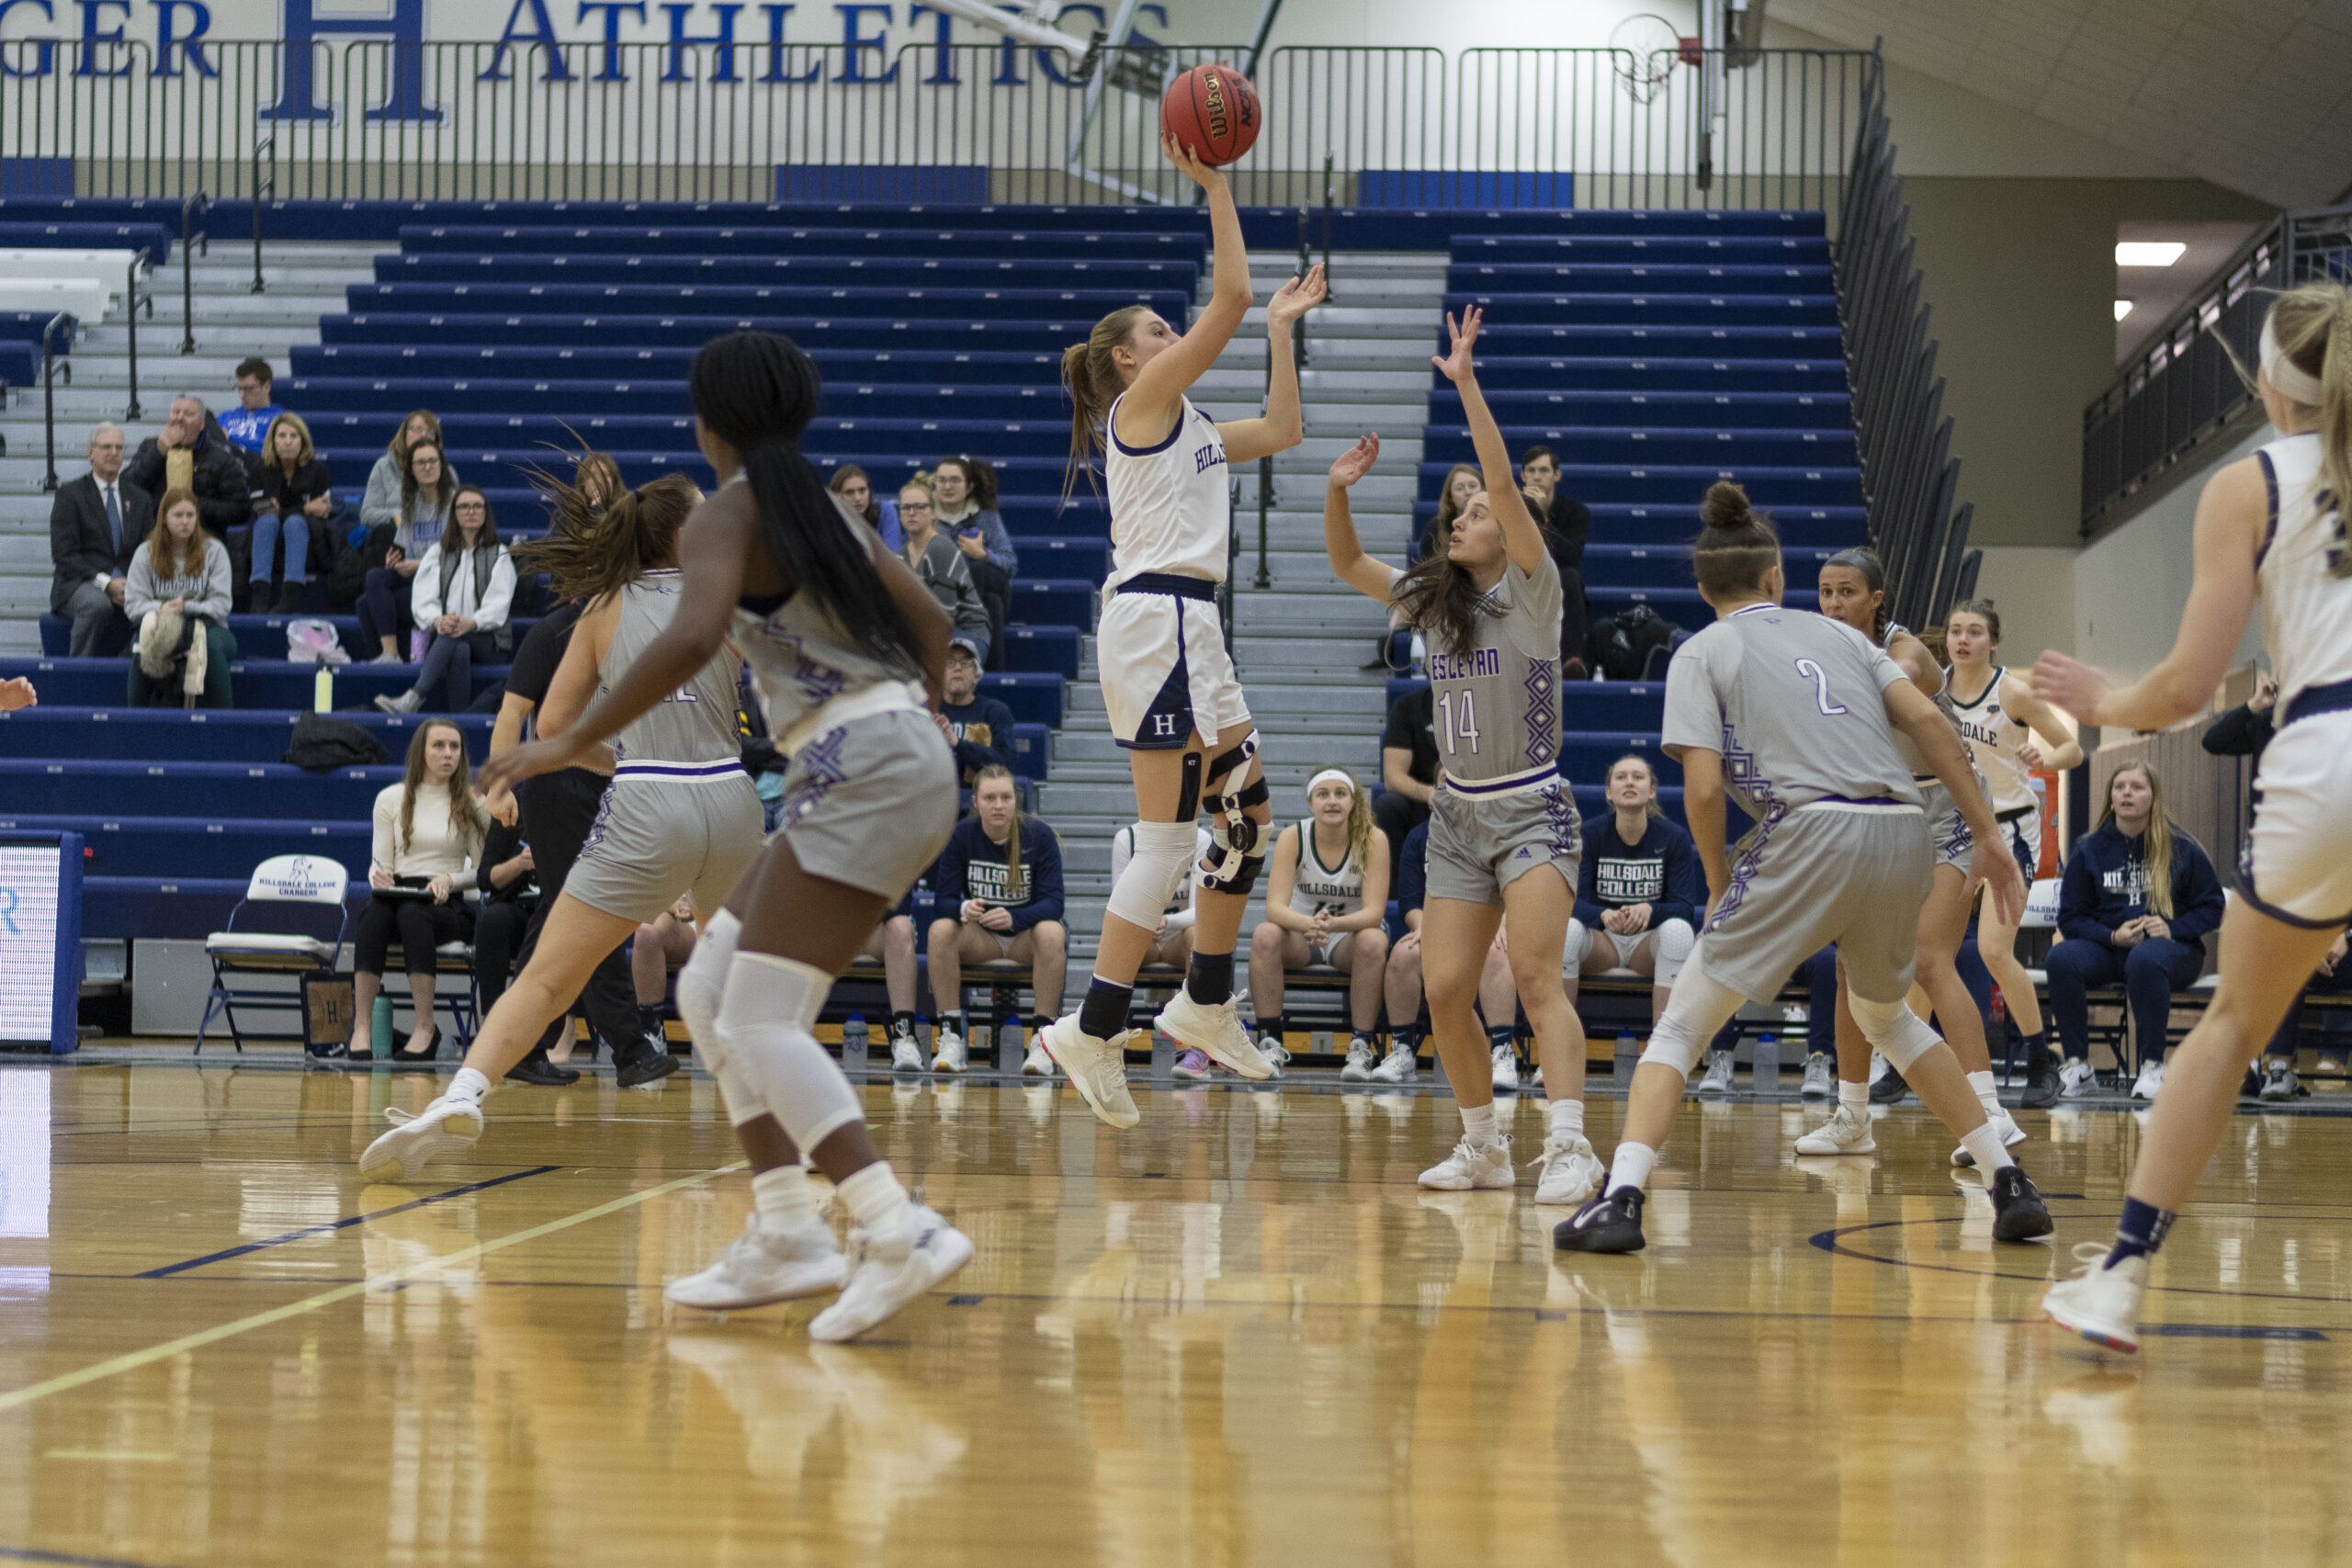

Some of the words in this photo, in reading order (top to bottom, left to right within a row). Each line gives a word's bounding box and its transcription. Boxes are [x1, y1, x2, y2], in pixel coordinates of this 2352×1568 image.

[0, 0, 220, 77] GER
[1203, 73, 1229, 140] Wilson
[1794, 657, 1848, 716] 2
[1153, 714, 1176, 735] H
[1439, 689, 1480, 755] 14
[1961, 721, 1997, 748] DALE
[259, 878, 301, 887] HILLSDALE
[967, 865, 1031, 885] HILLSDE
[1597, 863, 1663, 881] HILLSDALE
[278, 888, 318, 897] CHARGERS
[1596, 880, 1662, 897] COLLEGE
[2128, 893, 2141, 906] H
[326, 999, 338, 1025] H
